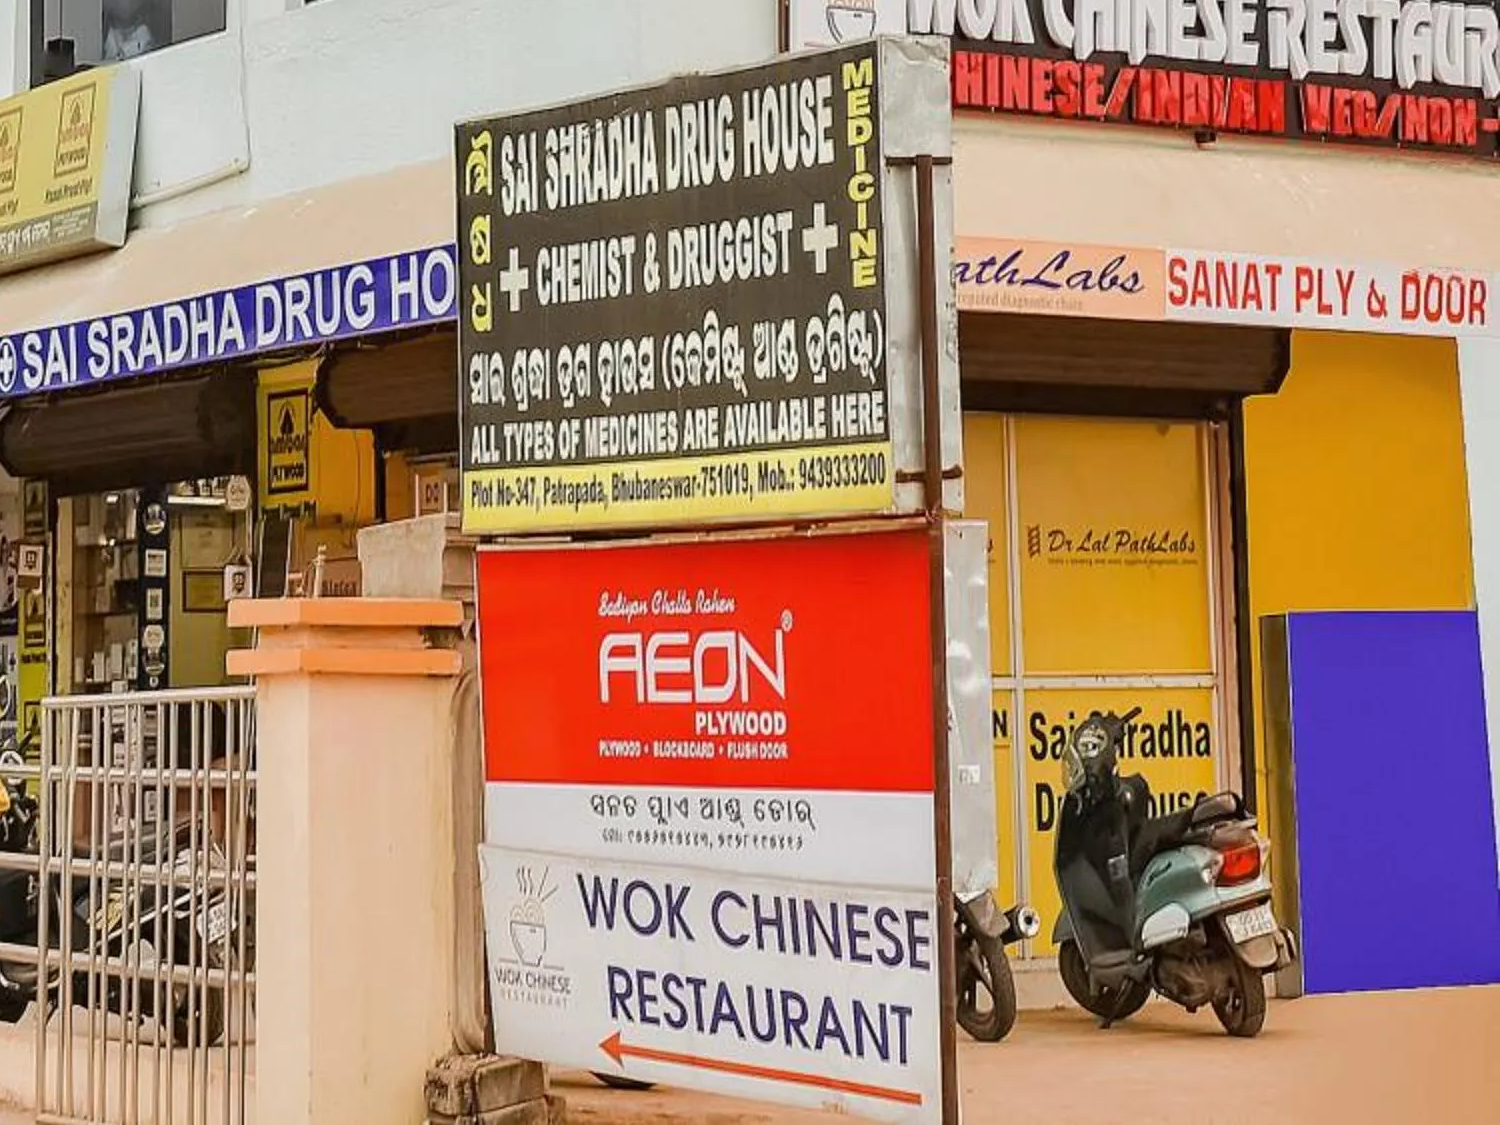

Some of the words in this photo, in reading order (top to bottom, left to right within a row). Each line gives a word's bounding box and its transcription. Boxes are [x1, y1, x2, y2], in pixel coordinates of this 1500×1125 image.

[953, 50, 1285, 134] HINESE/INDIAN
[1303, 83, 1500, 147] VEG/NON-
[501, 131, 539, 216] SAI
[544, 108, 659, 211] SHRADHA
[665, 94, 735, 193] DRUG
[741, 75, 835, 178] HOUSE
[841, 58, 878, 289] MEDICINE
[536, 235, 636, 306] CHEMIST
[643, 232, 661, 294] &
[667, 210, 794, 290] DRUGGIST
[954, 248, 1145, 294] athLabs
[1168, 258, 1283, 311] SANAT
[1295, 266, 1355, 316] PLY
[1367, 278, 1388, 318] &
[1401, 270, 1488, 326] DOOR
[23, 329, 77, 389] SAI
[87, 292, 244, 378] SRADHA
[254, 263, 376, 350] DRUG
[388, 248, 456, 322] HO
[471, 425, 500, 464] ALL
[503, 420, 554, 462] TYPES
[558, 424, 580, 459] OF
[584, 410, 679, 459] MEDICINES
[682, 405, 719, 450] ARE
[723, 395, 827, 446] AVAILABLE
[830, 389, 886, 437] HERE
[471, 479, 494, 508] Plot
[543, 477, 608, 512] Patrapada,
[799, 451, 886, 490] 9439333200
[1048, 530, 1072, 552] Dr
[1075, 530, 1110, 553] Lal
[1113, 529, 1196, 554] PathLabs
[599, 628, 785, 704] AEON
[599, 739, 641, 757] PLYWOOD
[653, 740, 715, 758] BLOCKBOARD
[727, 742, 758, 759] FLUSH
[759, 742, 789, 759] DOOR
[695, 710, 787, 735] PLYWOOD
[577, 873, 696, 942] WOK
[710, 890, 931, 972] CHINESE
[607, 965, 913, 1065] RESTAURANT
